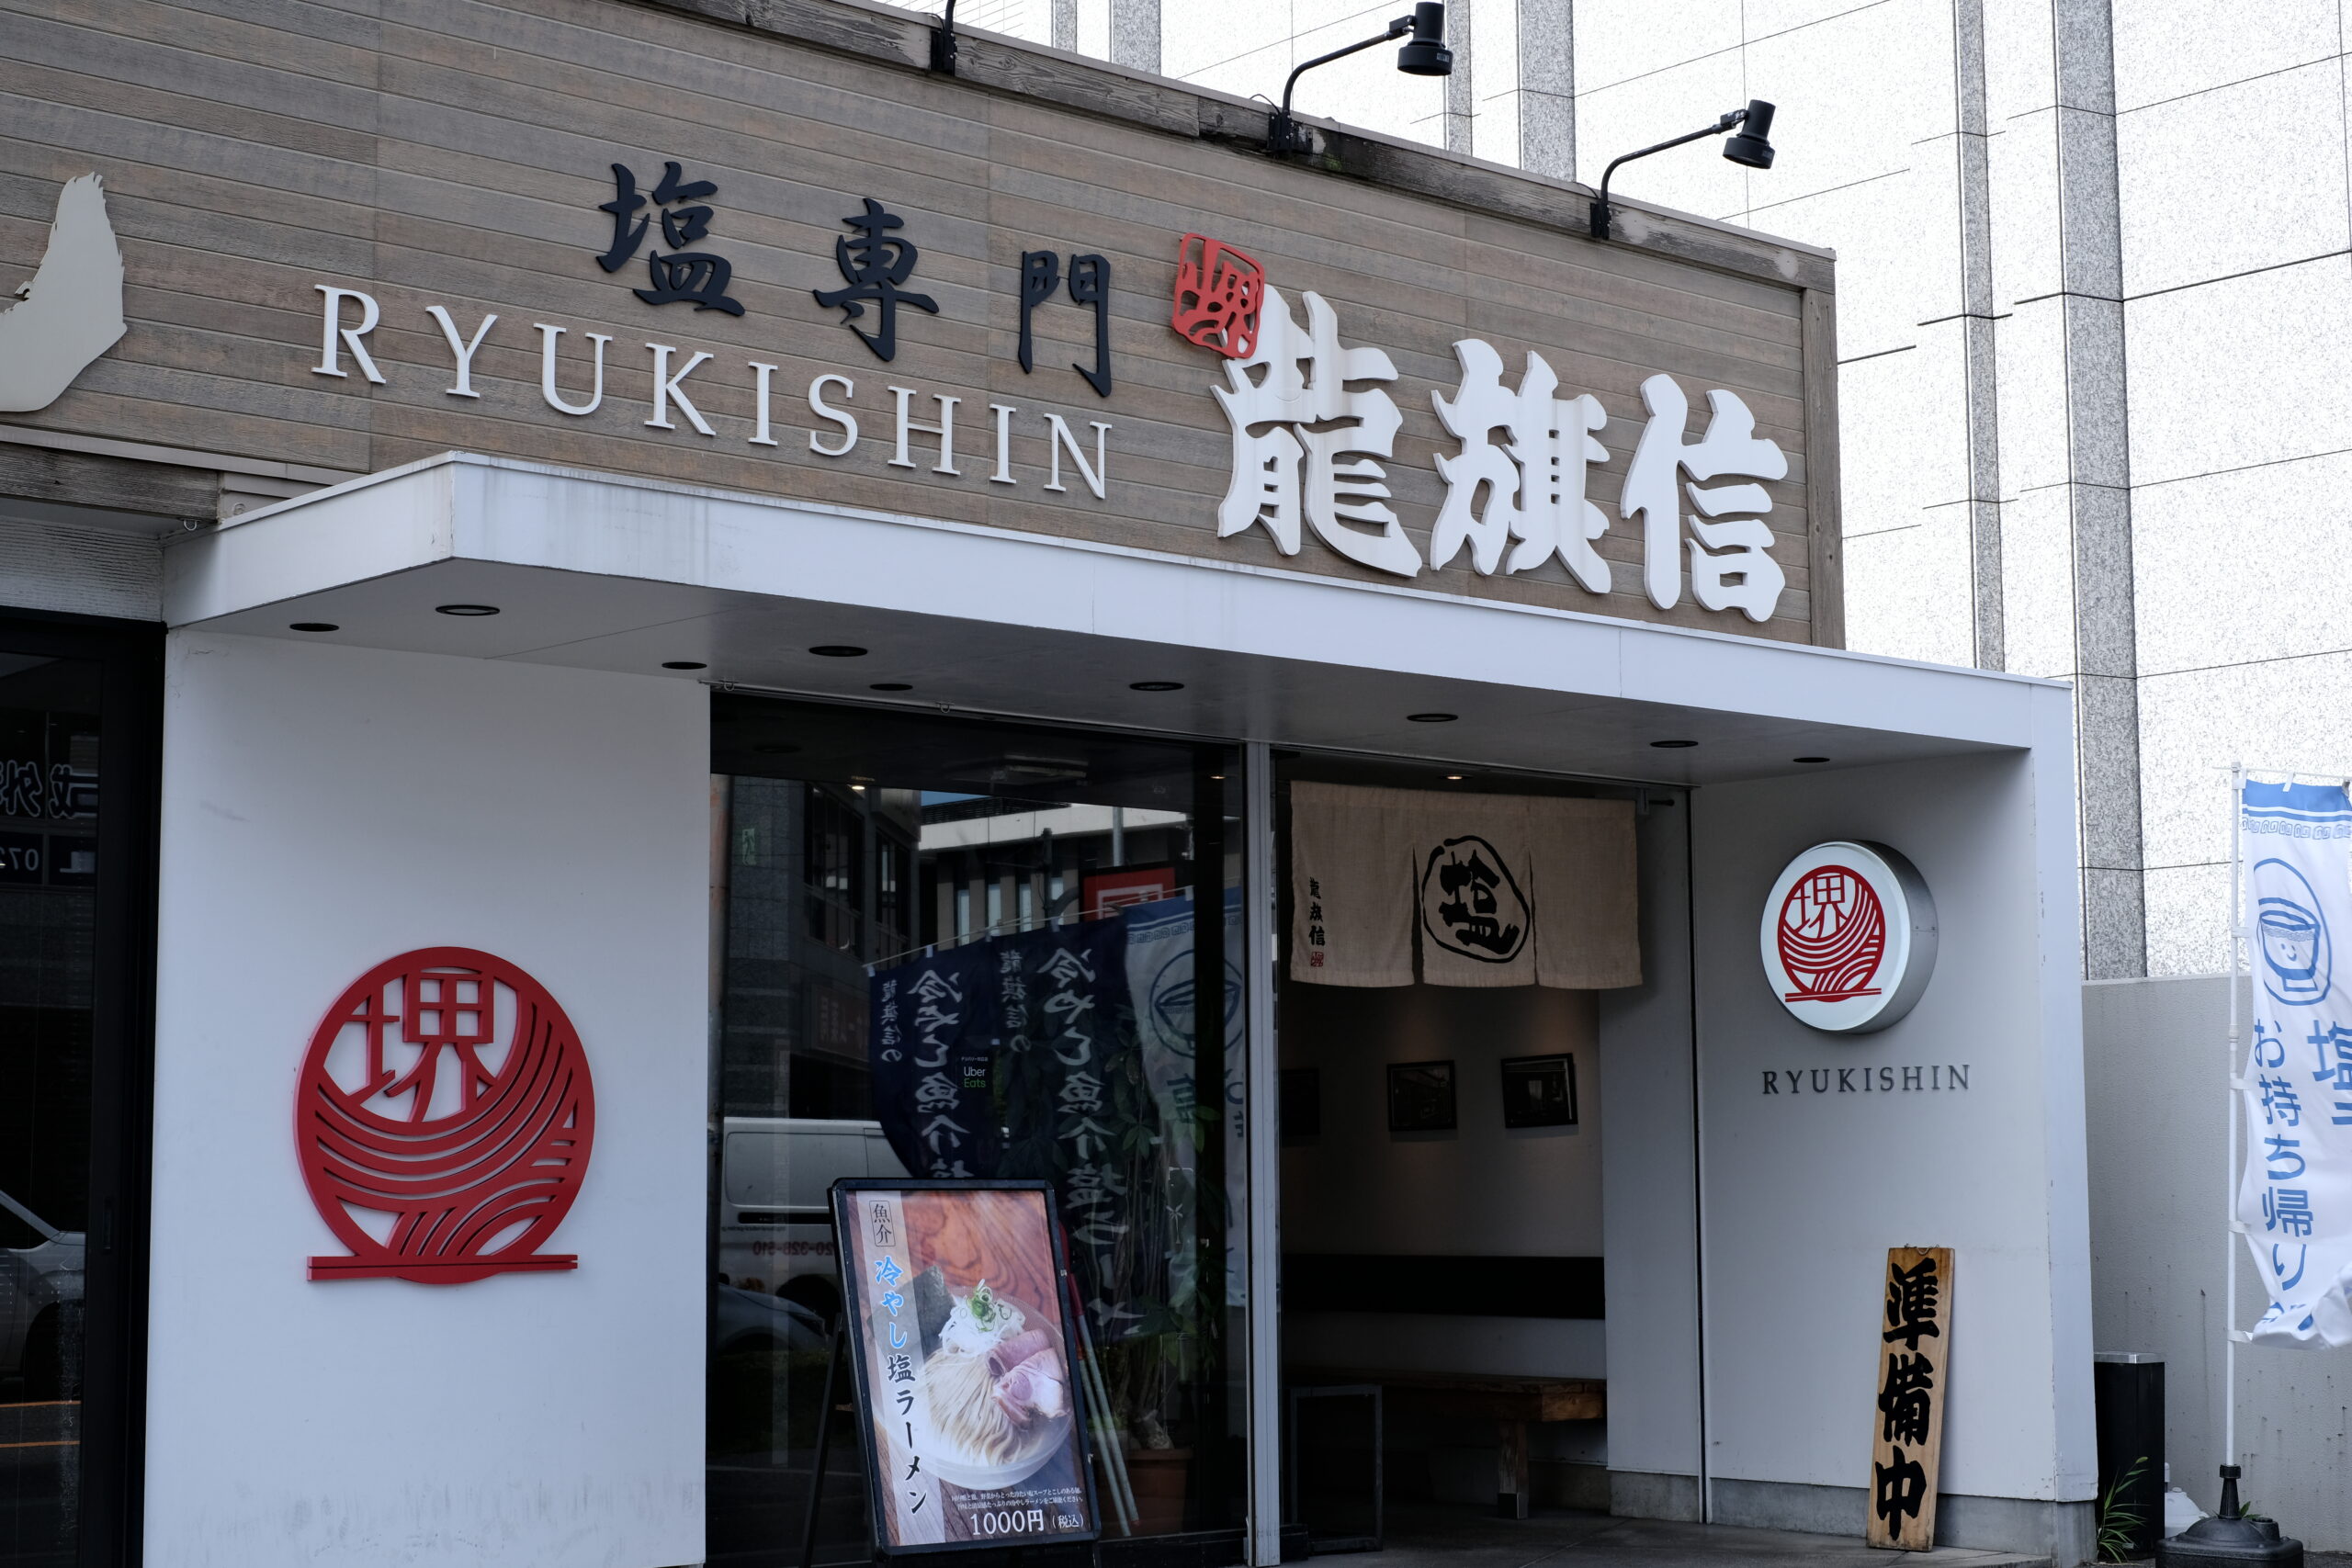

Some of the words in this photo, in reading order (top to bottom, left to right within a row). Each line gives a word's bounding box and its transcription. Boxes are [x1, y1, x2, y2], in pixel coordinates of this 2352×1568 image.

[596, 162, 1112, 397] 塩専門
[311, 284, 1112, 499] RYUKISHIN
[1210, 284, 1789, 623] 龍旗信
[964, 1066, 986, 1077] Uber
[964, 1077, 986, 1089] Eats
[1762, 1065, 1970, 1095] RYUKISHIN
[2254, 1018, 2315, 1330] お持ち帰り
[874, 1202, 893, 1246] 魚介
[874, 1255, 928, 1515] 冷やし塩ラーメン
[1875, 1257, 1939, 1541] 準備中
[970, 1509, 1046, 1536] 1000円
